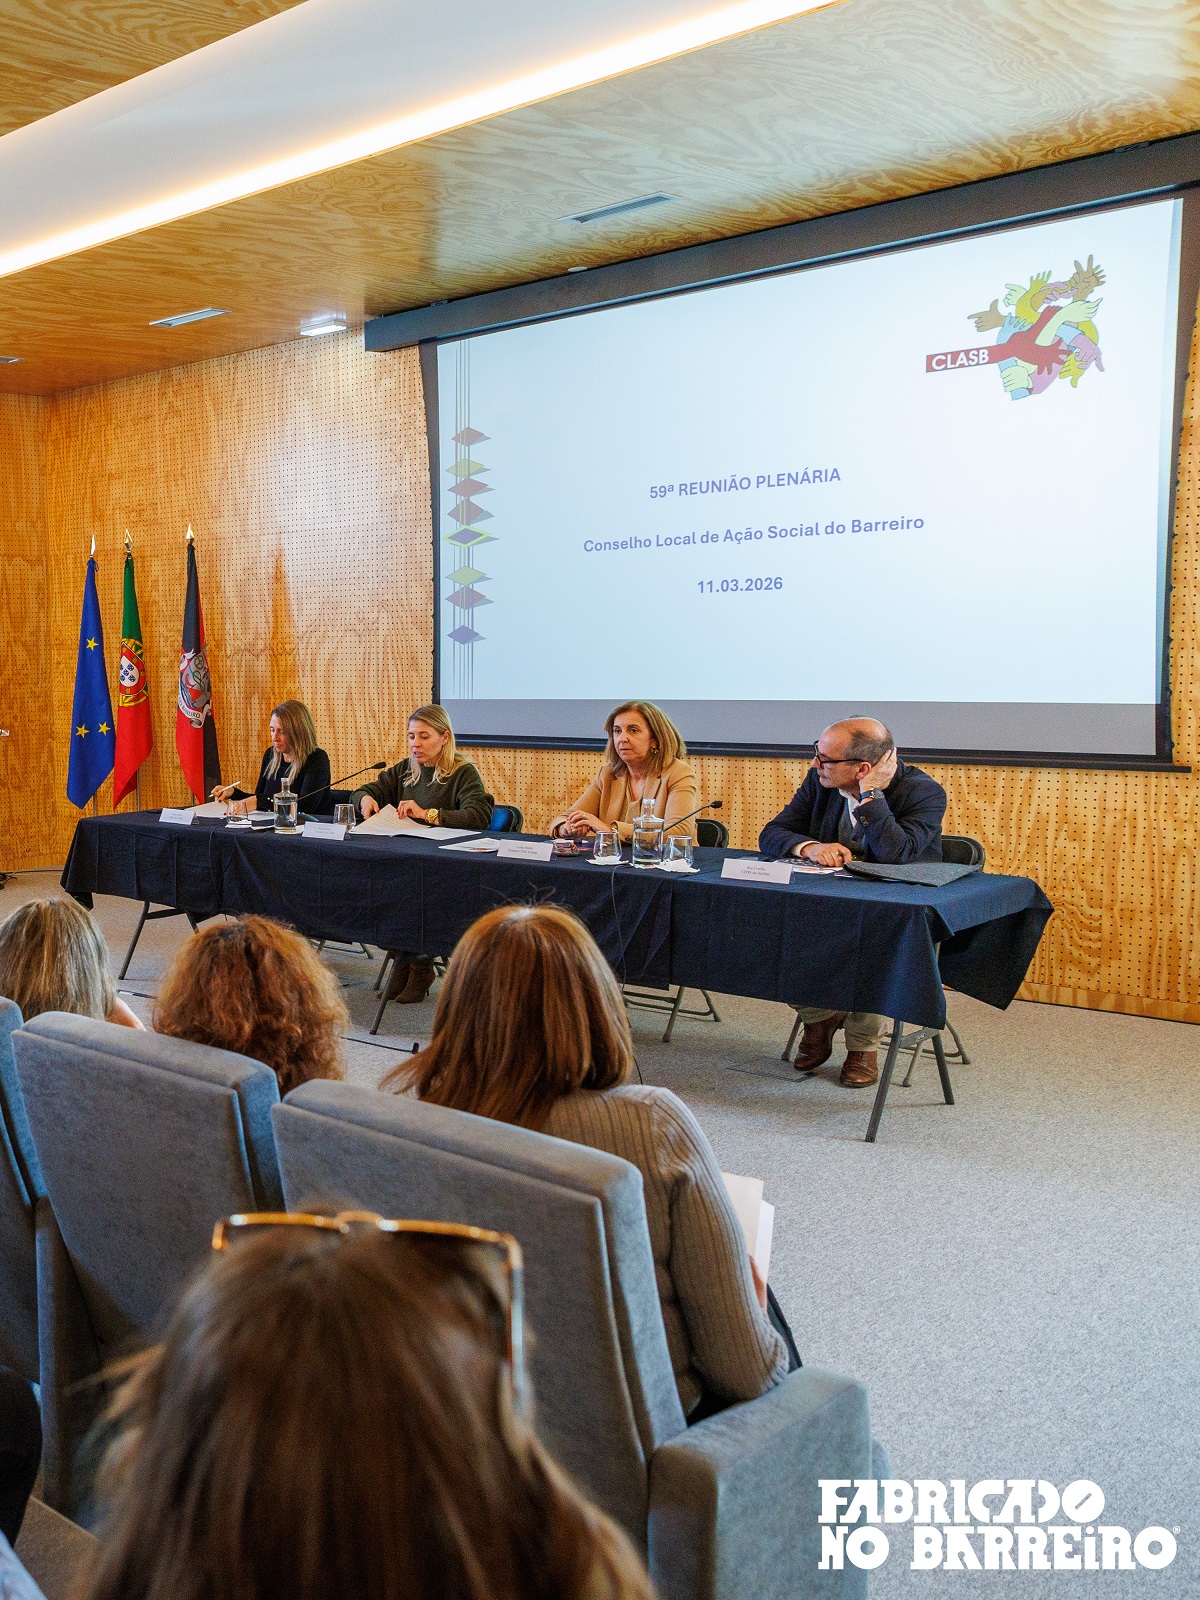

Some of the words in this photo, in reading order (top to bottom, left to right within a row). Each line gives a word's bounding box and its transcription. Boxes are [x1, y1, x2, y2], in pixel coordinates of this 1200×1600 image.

[931, 349, 989, 370] CLASB
[649, 484, 675, 499] 59ª
[678, 474, 752, 496] REUNIÃO
[756, 467, 841, 489] PLENÁRIA
[583, 536, 652, 552] Conselho
[656, 532, 697, 547] Local
[700, 531, 720, 543] de
[723, 527, 764, 545] Ação
[767, 522, 820, 539] Social
[824, 521, 846, 535] do
[851, 516, 925, 533] Barreiro
[697, 576, 784, 594] 11.03.2026
